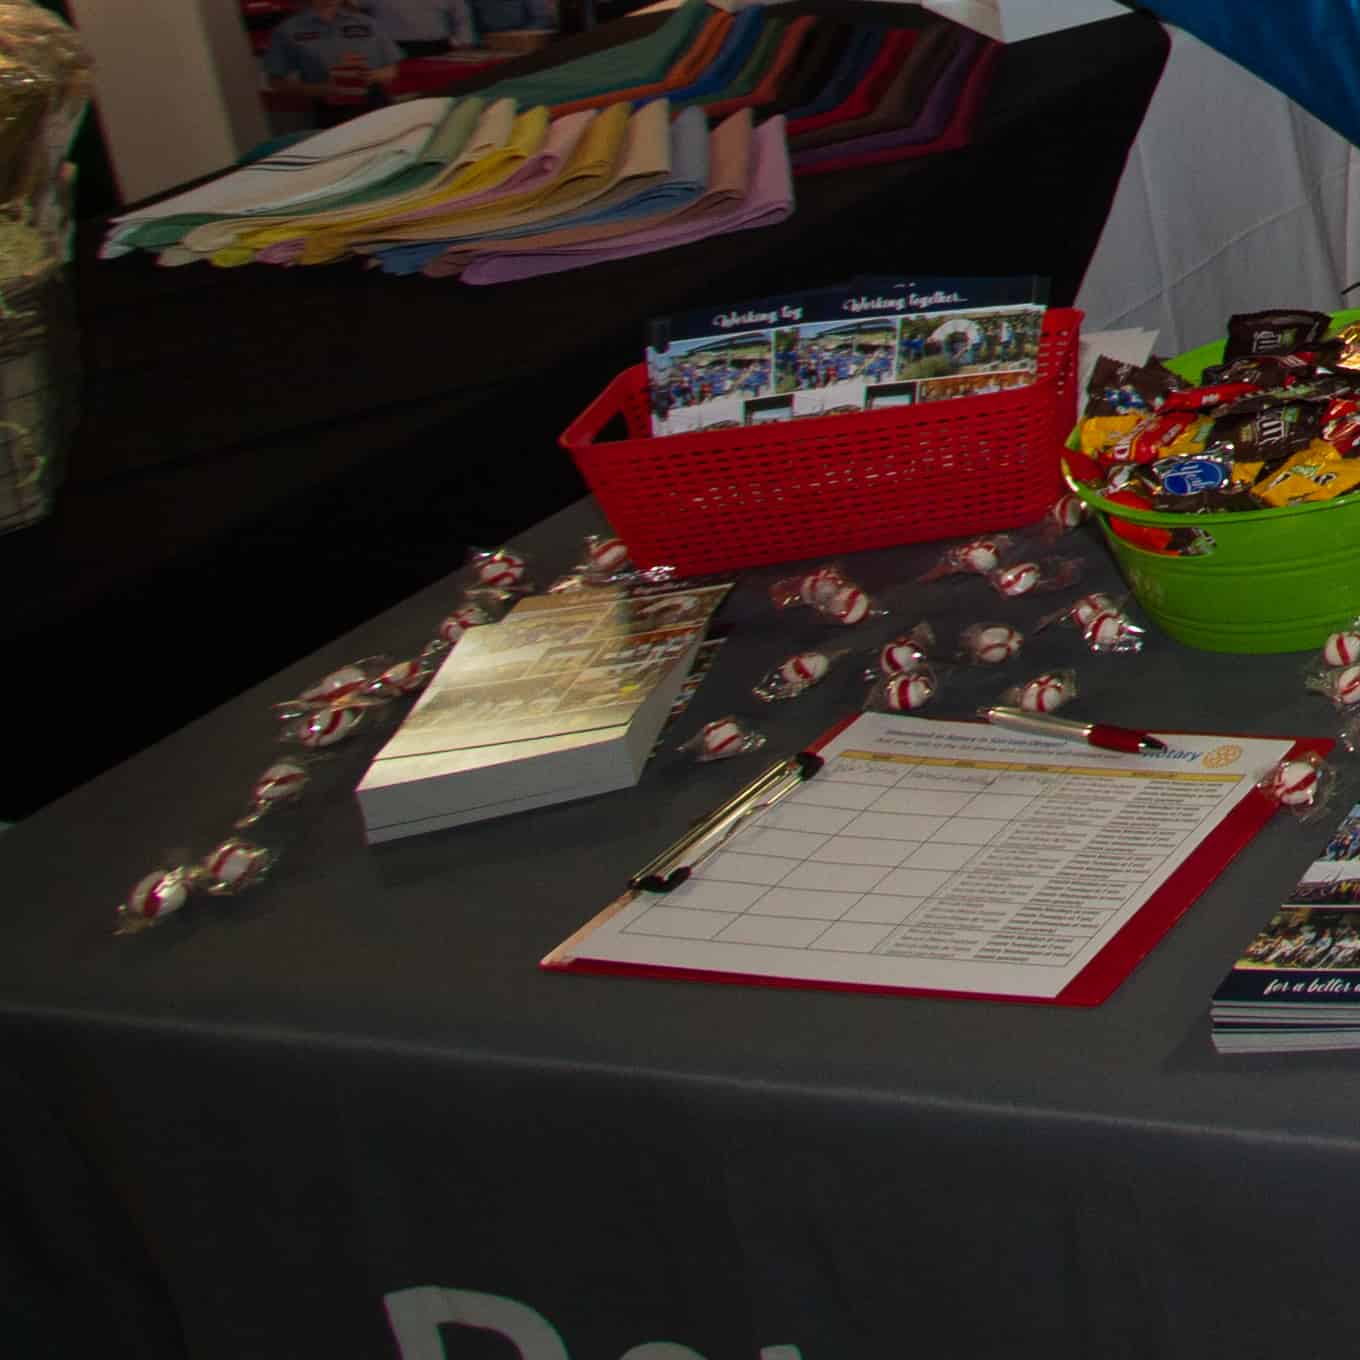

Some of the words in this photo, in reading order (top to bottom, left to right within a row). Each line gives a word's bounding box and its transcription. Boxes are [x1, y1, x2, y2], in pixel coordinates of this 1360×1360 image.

[843, 296, 906, 313] Working
[712, 310, 777, 329] Working
[778, 305, 803, 325] tog
[1263, 979, 1289, 996] for
[1290, 983, 1305, 992] a
[1307, 977, 1352, 994] better
